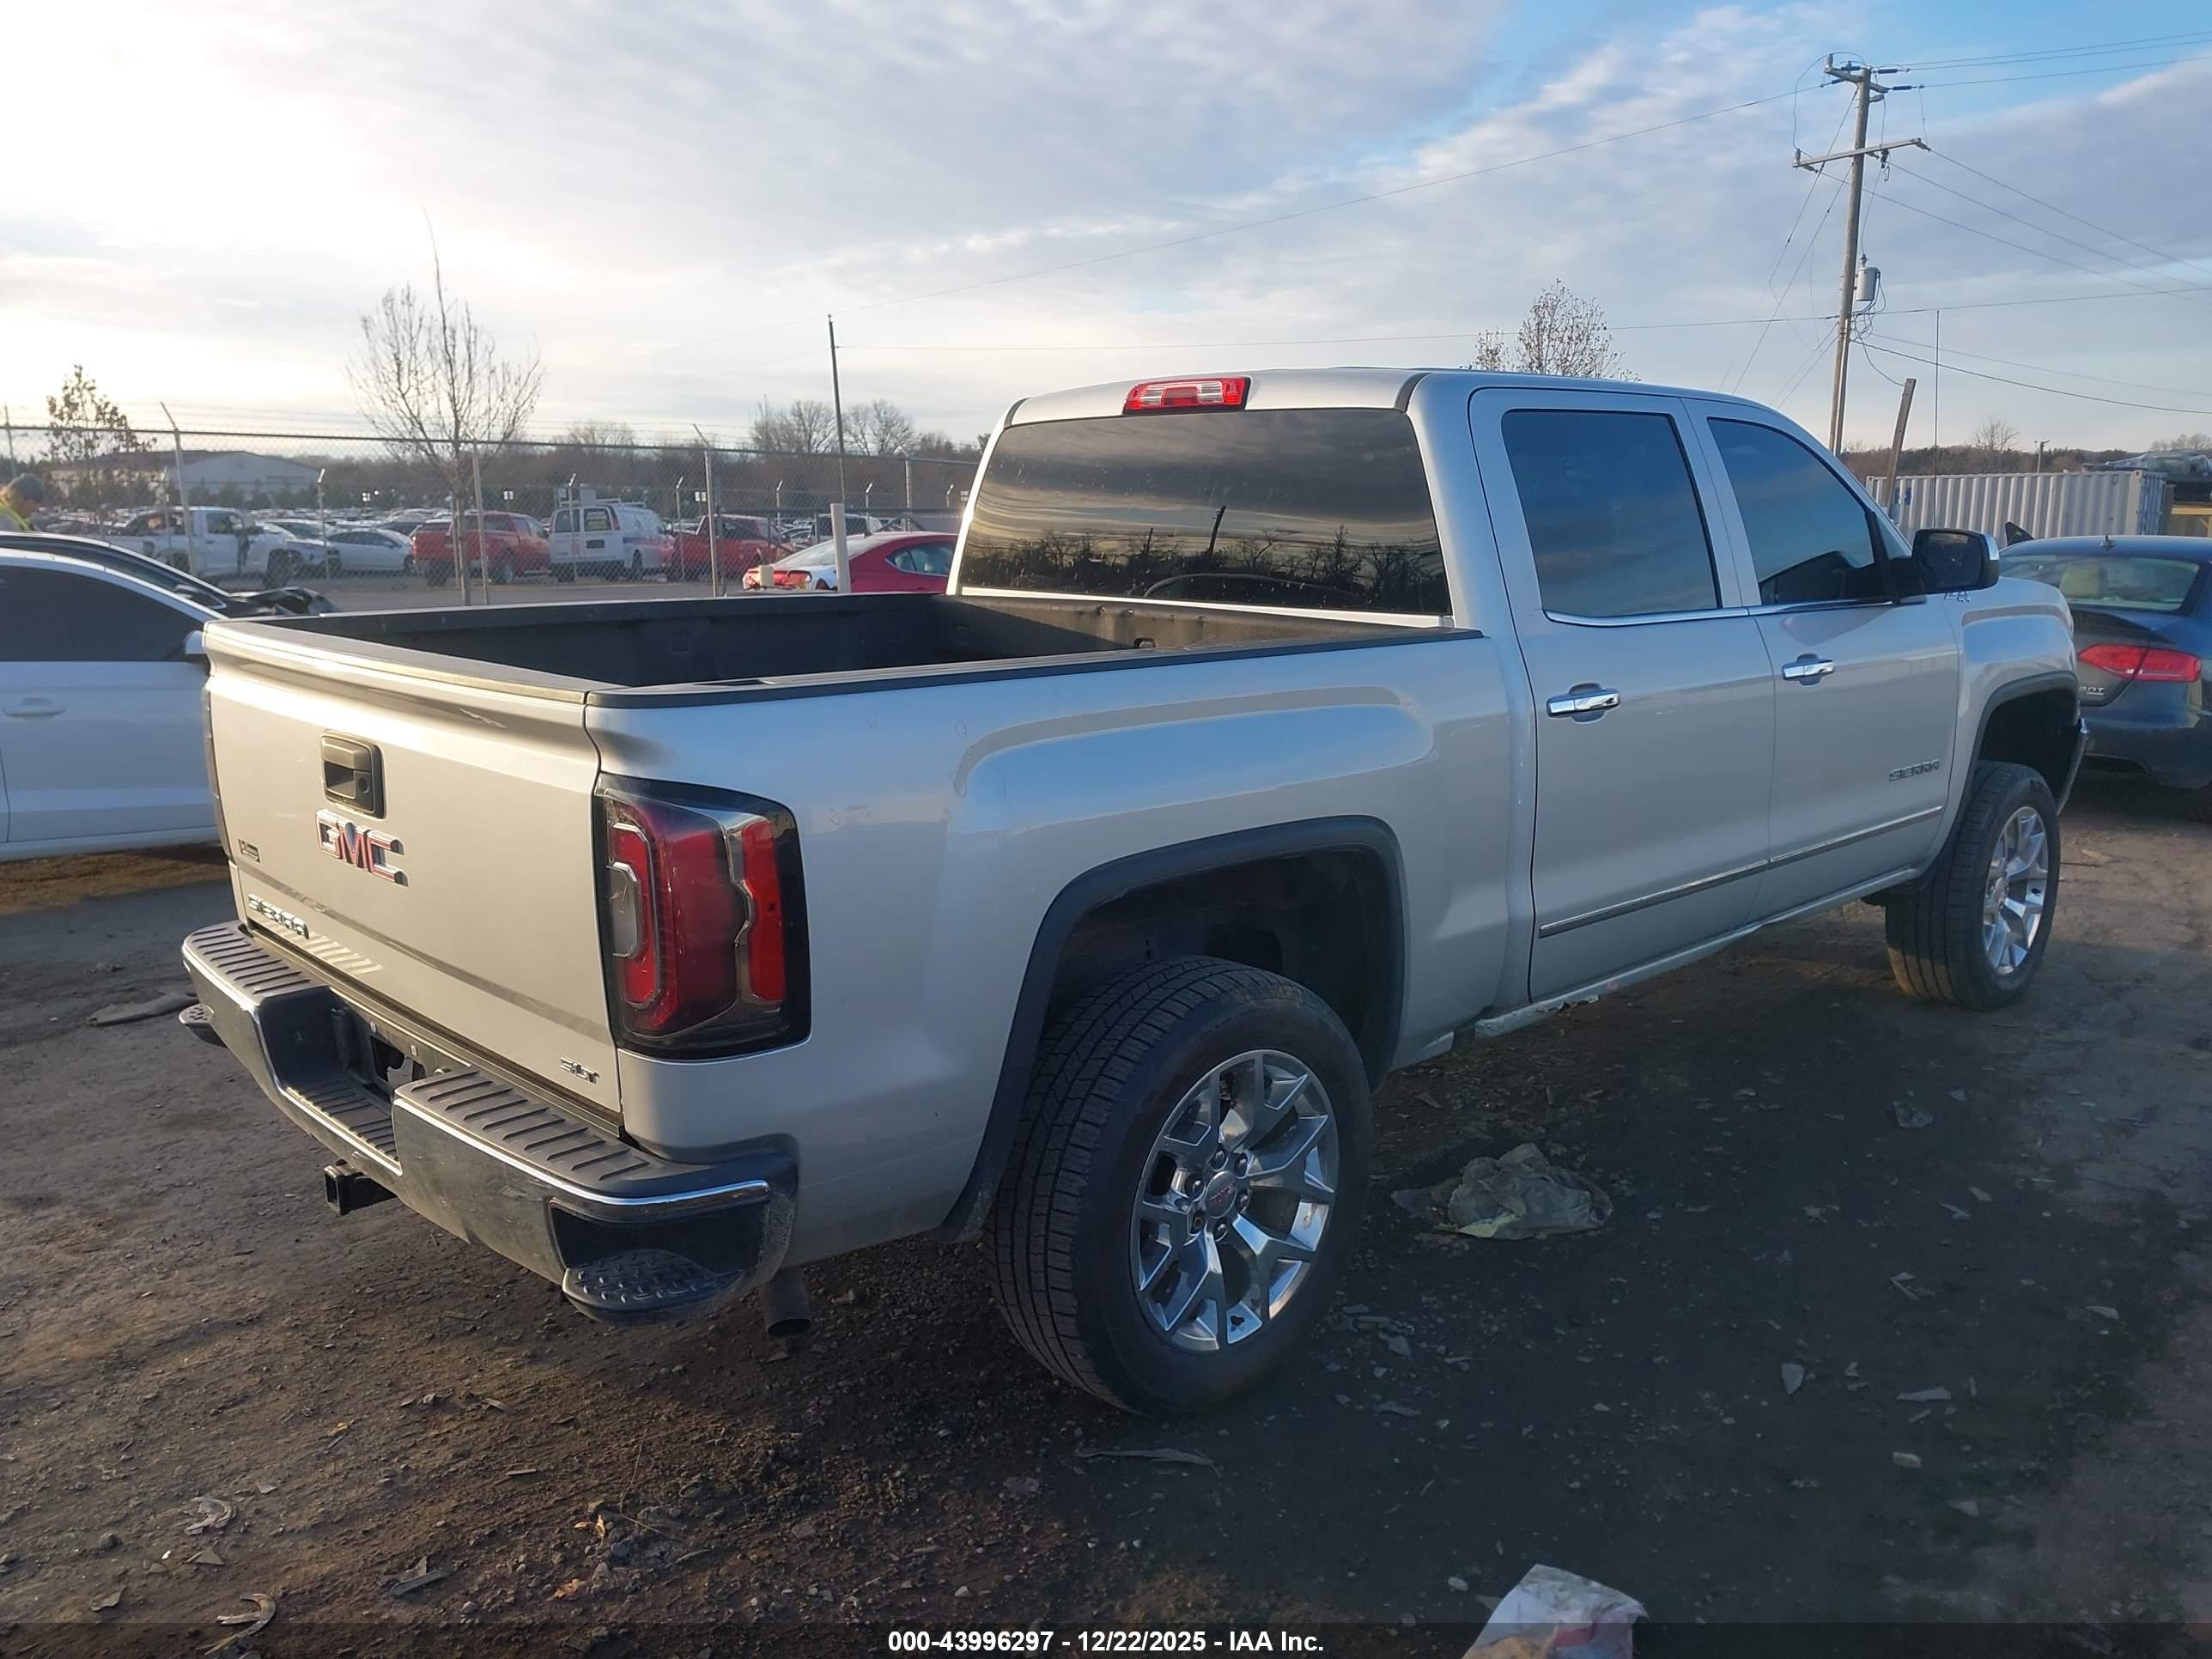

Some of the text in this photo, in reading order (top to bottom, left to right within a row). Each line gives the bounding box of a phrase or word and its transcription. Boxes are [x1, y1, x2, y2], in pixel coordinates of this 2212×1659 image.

[1888, 759, 1940, 781] SIERRA
[315, 808, 409, 887] GMC
[560, 1056, 600, 1085] SLT
